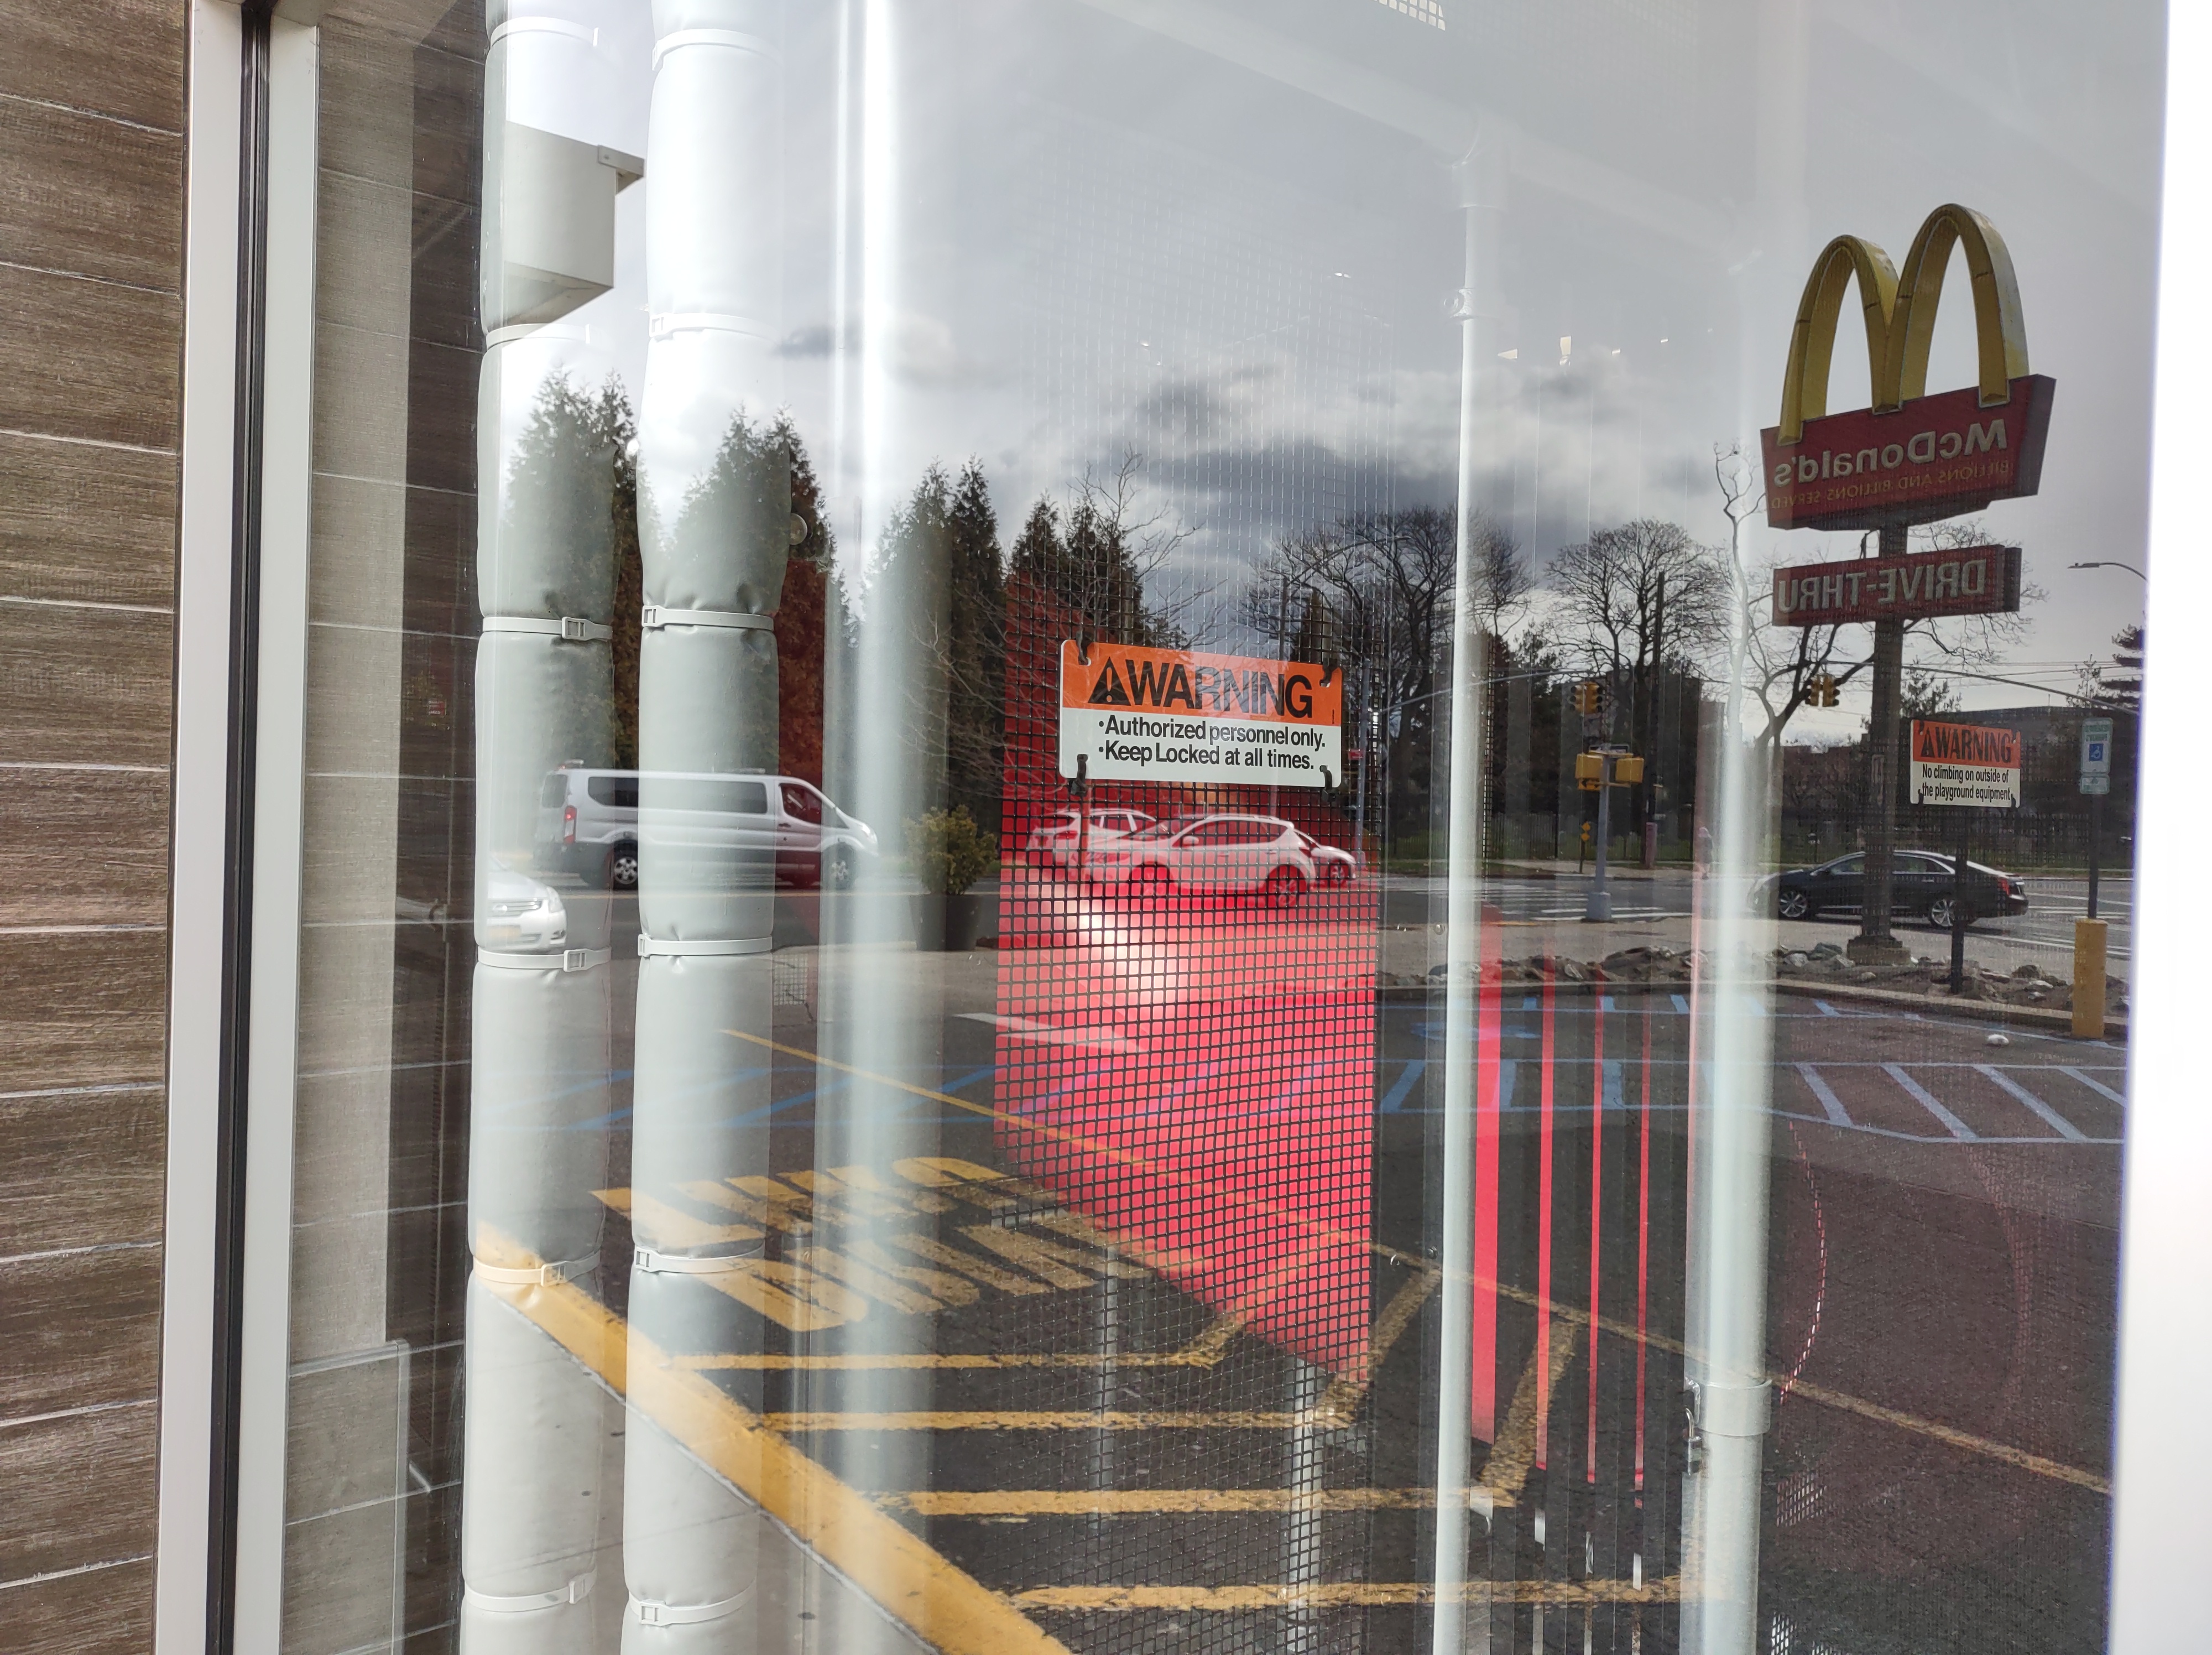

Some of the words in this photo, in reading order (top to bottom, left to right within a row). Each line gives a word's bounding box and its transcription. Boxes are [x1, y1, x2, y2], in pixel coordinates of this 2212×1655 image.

[1125, 659, 1313, 719] WARNING
[1105, 714, 1206, 740] Authorized
[1209, 724, 1288, 745] personnel
[1291, 727, 1326, 752] only.
[1935, 726, 2011, 763] WARNING
[1105, 740, 1152, 767] Keep
[1156, 742, 1219, 766] Locked
[1224, 748, 1240, 766] at
[1244, 748, 1262, 767] all
[1267, 749, 1314, 770] times.
[1922, 763, 1932, 778] No
[1934, 764, 1963, 784] climbing
[1965, 771, 1974, 781] on
[1976, 768, 2001, 783] outside
[2002, 769, 2009, 783] of
[1922, 782, 1933, 797] the
[1935, 783, 1974, 801] playground
